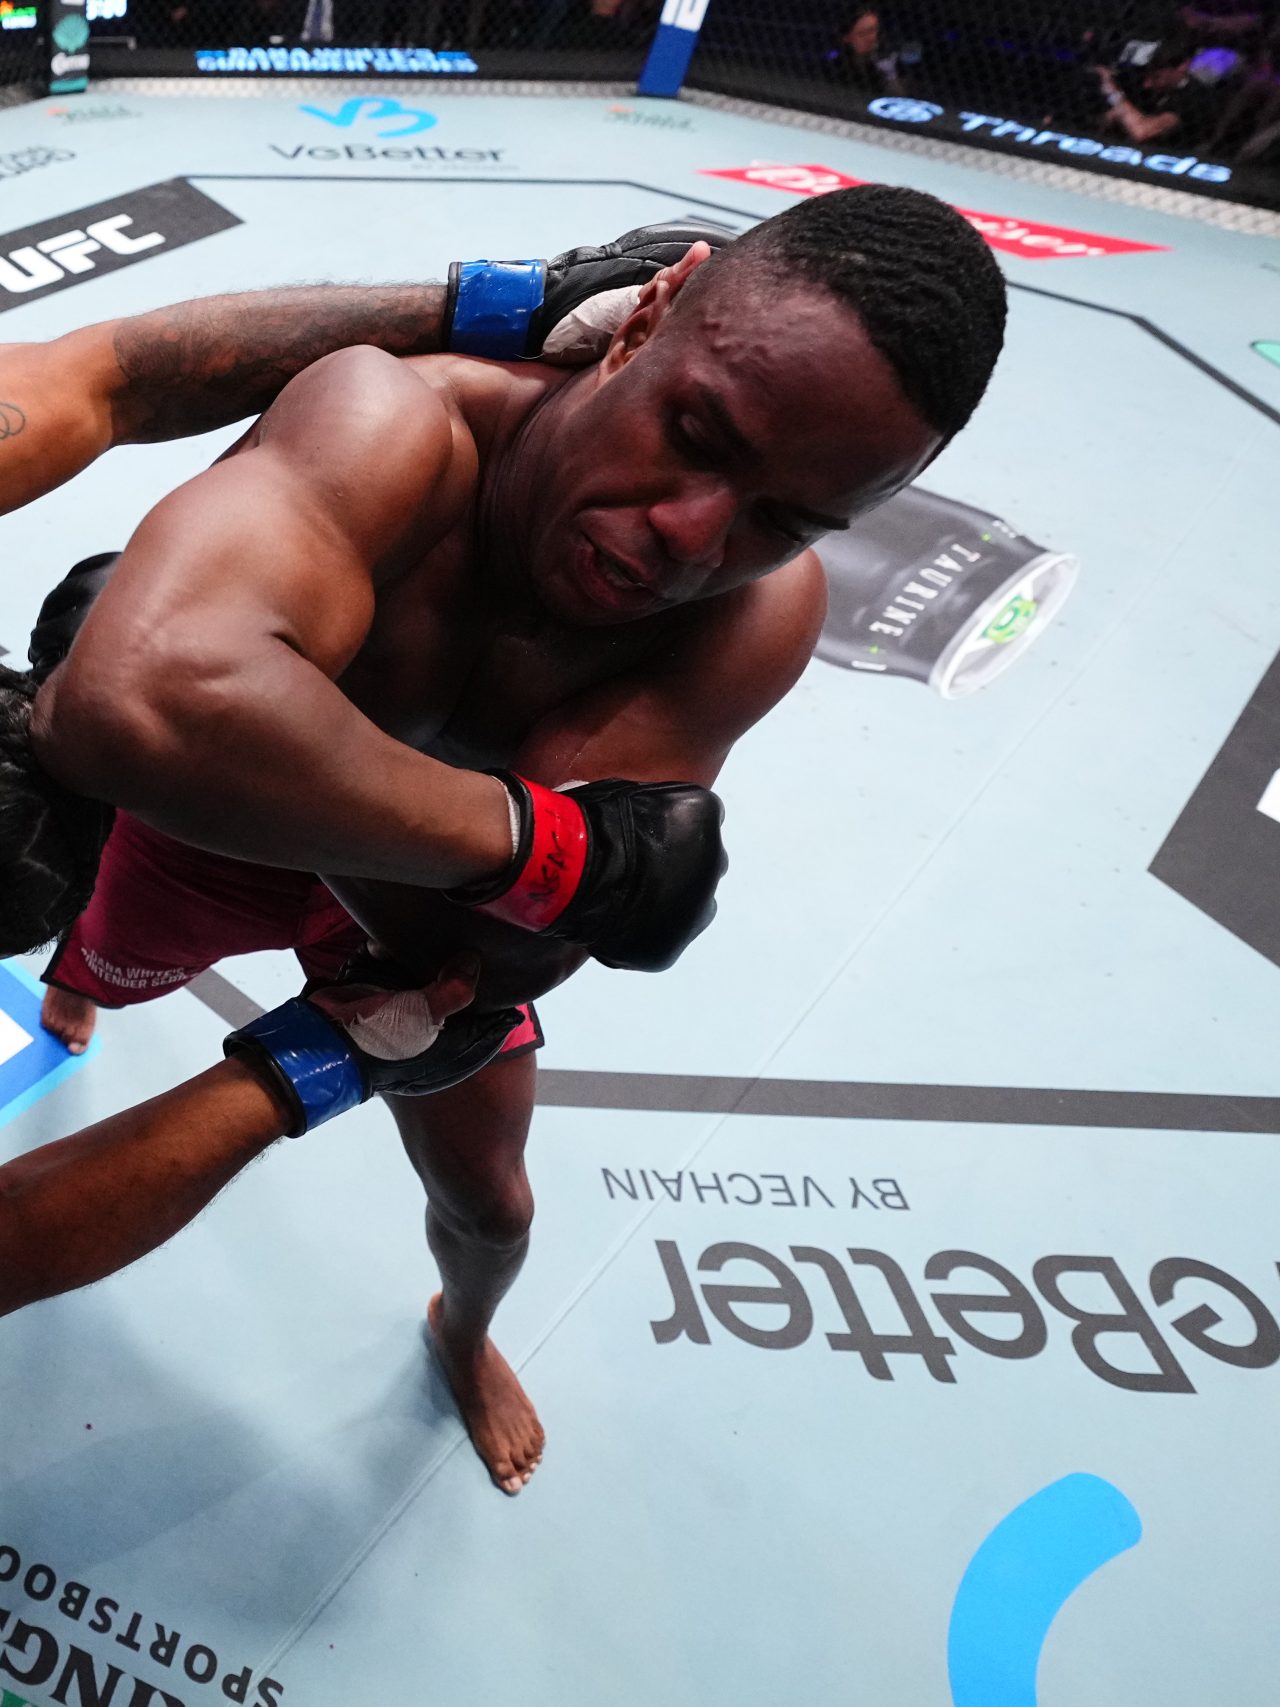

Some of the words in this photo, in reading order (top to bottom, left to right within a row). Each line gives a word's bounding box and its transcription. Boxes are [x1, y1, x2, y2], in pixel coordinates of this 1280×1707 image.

[959, 110, 1233, 184] Threads
[869, 543, 981, 637] TAURINE
[600, 1166, 836, 1210] VECHAIN
[849, 1176, 911, 1211] BY
[649, 1239, 1280, 1394] eBetter
